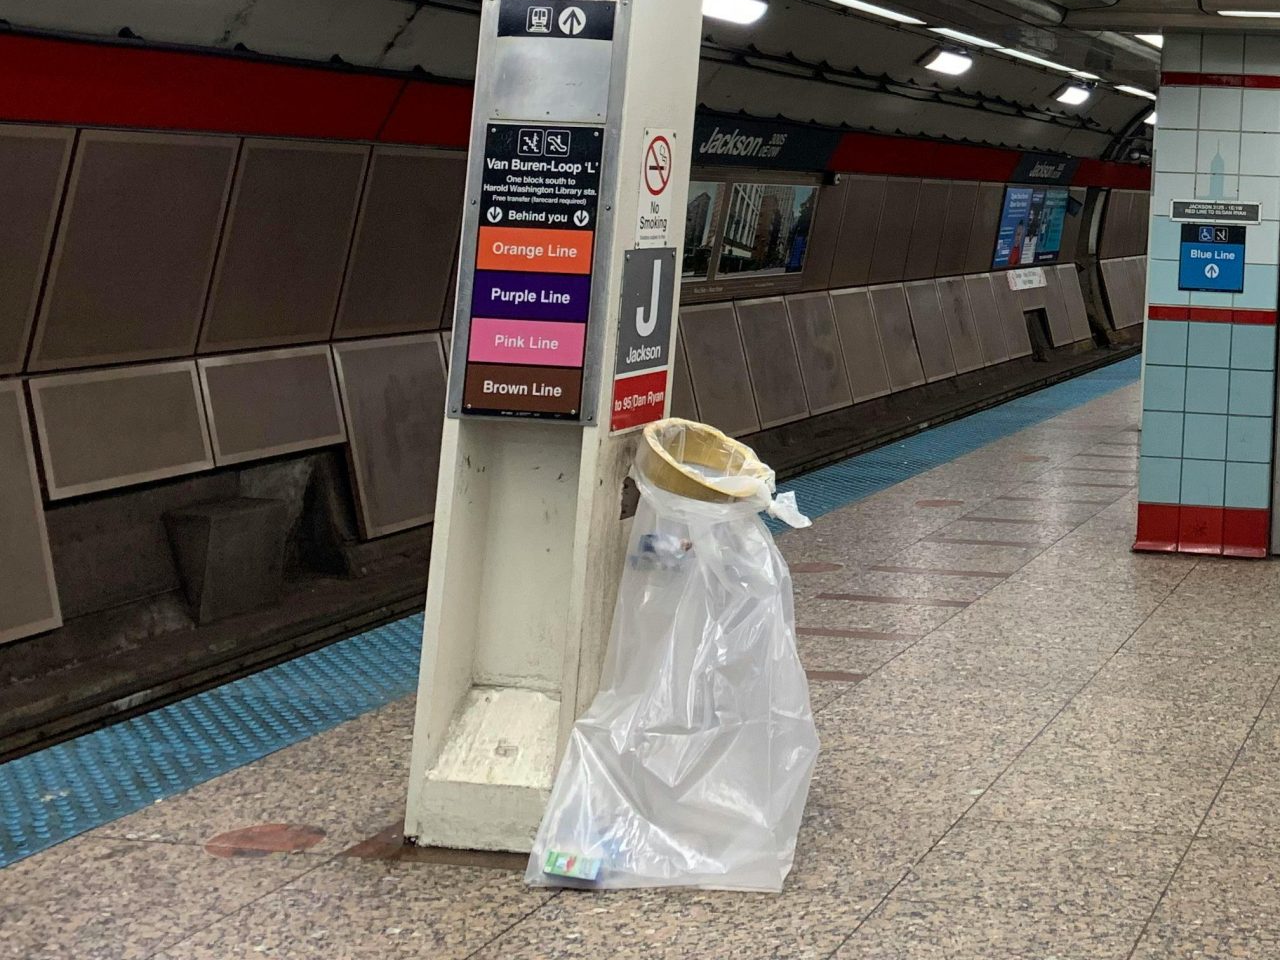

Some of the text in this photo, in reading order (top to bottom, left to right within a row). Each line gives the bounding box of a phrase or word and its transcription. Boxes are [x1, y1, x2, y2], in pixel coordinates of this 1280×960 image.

[699, 127, 763, 156] Jackson
[487, 158, 508, 170] Van
[512, 159, 582, 175] Buren-Loop
[506, 175, 522, 183] One
[524, 176, 544, 184] block
[484, 184, 508, 192] Harold
[510, 185, 554, 195] Washington
[556, 187, 582, 197] Library
[650, 201, 659, 214] No
[508, 210, 568, 224] Behind you
[640, 216, 667, 232] Smoking
[493, 242, 577, 259] Orange Line
[1190, 250, 1235, 260] Blue Line
[491, 288, 570, 304] Purple Line
[636, 260, 661, 336] J
[495, 334, 559, 350] Pink Line
[626, 345, 661, 364] Jackson
[483, 380, 562, 397] Brown Line
[615, 400, 622, 412] to
[647, 391, 664, 406] Ryan
